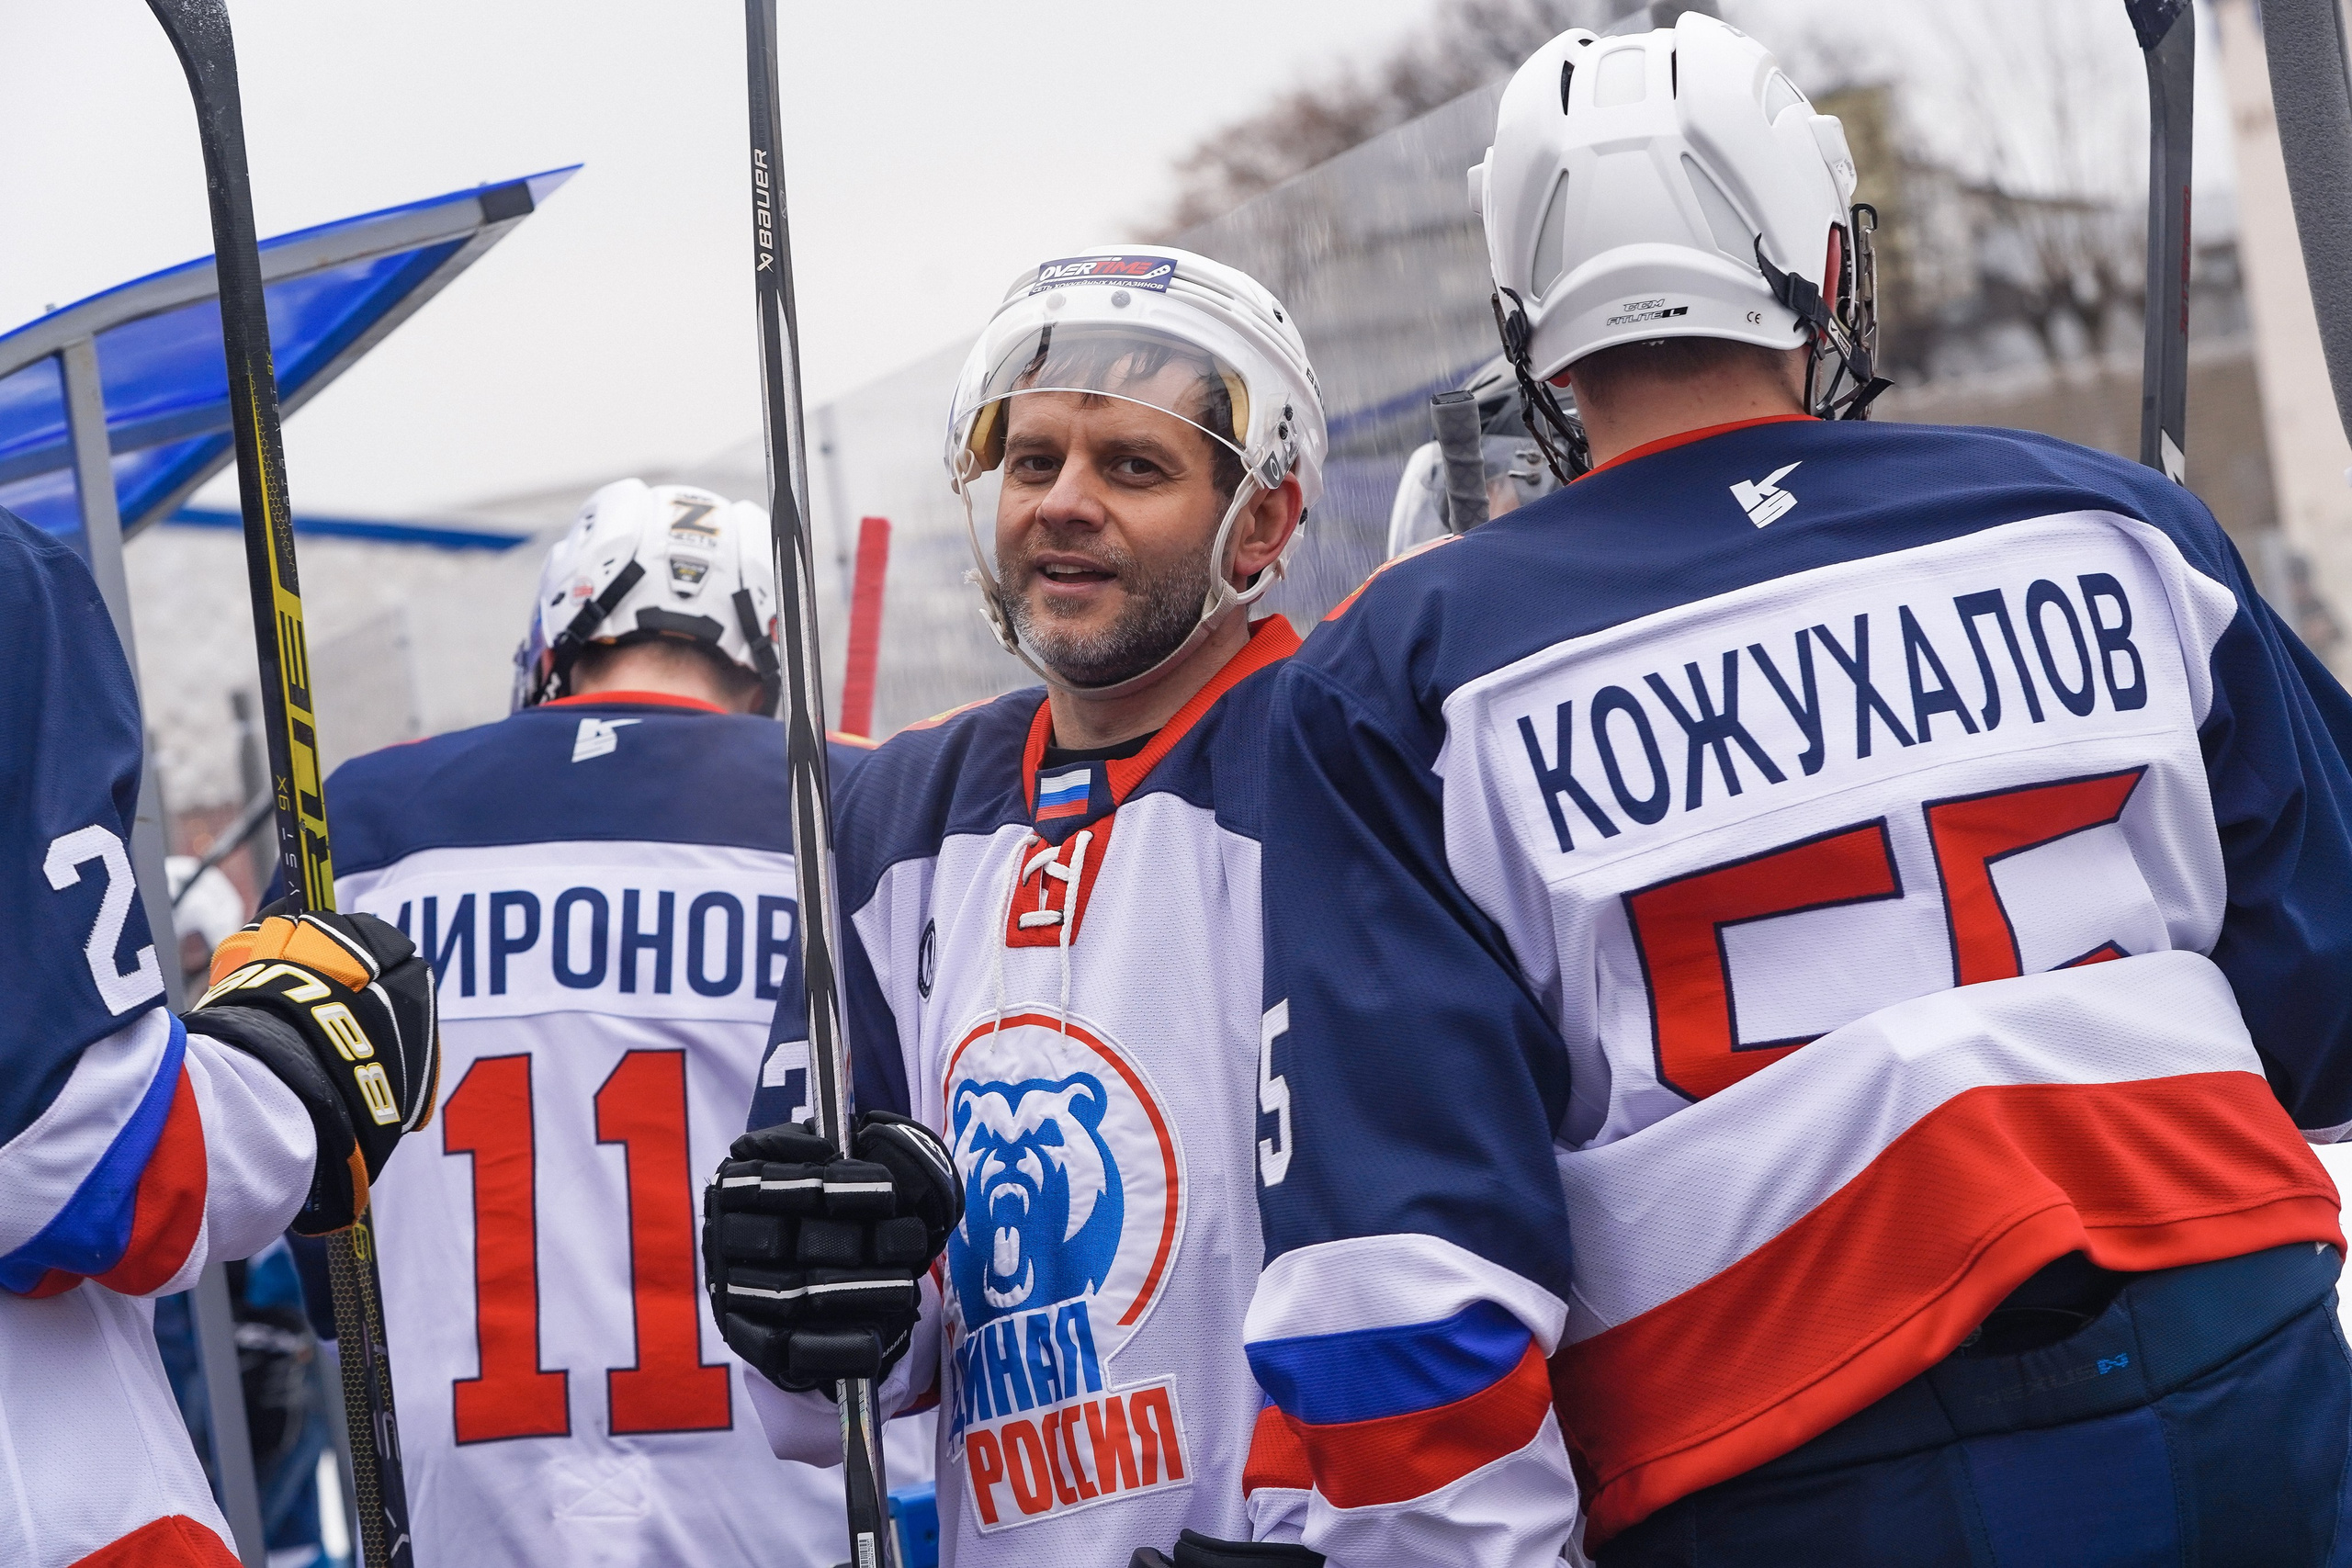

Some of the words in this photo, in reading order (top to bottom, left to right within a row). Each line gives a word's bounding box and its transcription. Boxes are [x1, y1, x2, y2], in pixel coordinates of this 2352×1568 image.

[753, 148, 774, 250] BAUER
[1039, 258, 1152, 280] OVERTIME
[1108, 279, 1166, 290] МАГАЗИНОВ
[1623, 299, 1666, 312] CCM
[1747, 310, 1762, 324] CE
[669, 499, 721, 537] Z
[1516, 570, 2148, 854] КОЖУХАЛОВ
[42, 823, 166, 1017] 2
[1258, 997, 1294, 1188] 5
[442, 1048, 733, 1448] 11
[948, 1300, 1103, 1455] ДИНАЯ
[966, 1386, 1185, 1526] РОССИЯ
